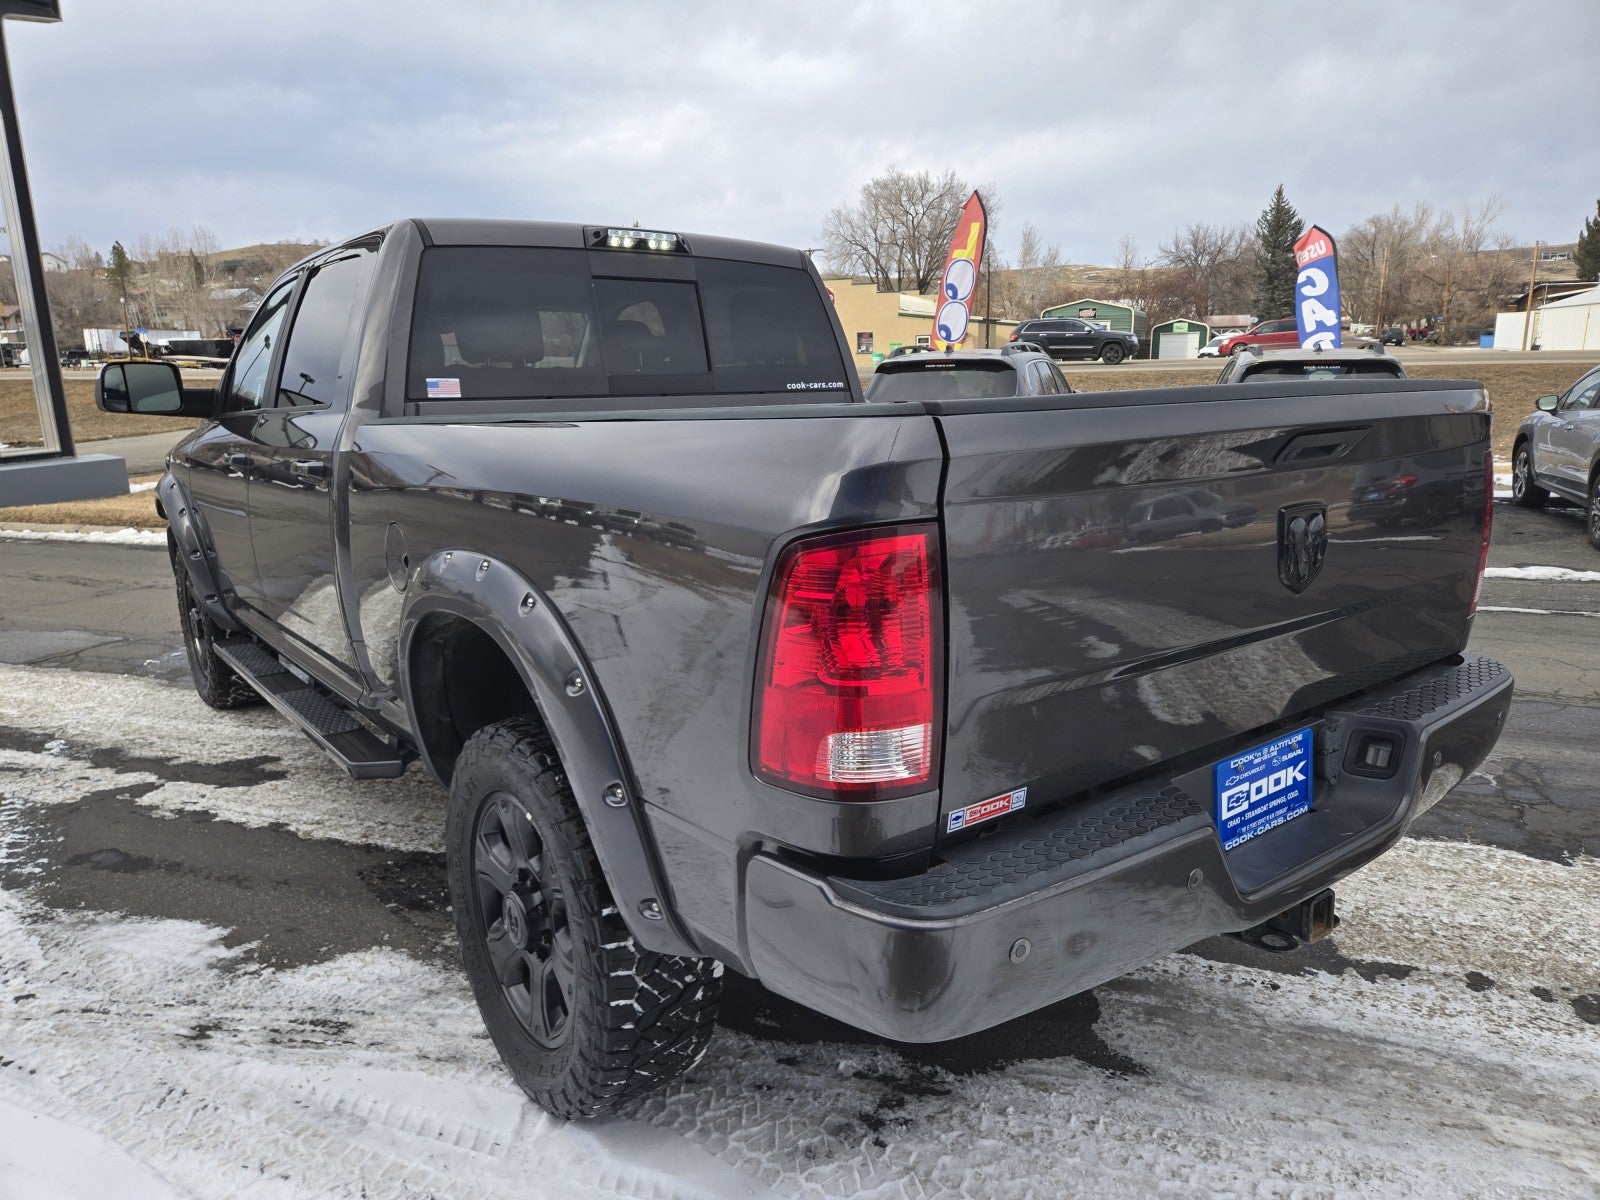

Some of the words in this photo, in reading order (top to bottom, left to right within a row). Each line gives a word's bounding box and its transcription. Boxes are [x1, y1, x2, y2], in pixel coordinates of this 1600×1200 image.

[786, 381, 844, 389] cook-cars.com
[1269, 733, 1303, 752] ALTITUDE
[1281, 748, 1304, 762] SUBARU
[1222, 760, 1307, 821] COOK
[966, 797, 1010, 821] COOK
[1225, 804, 1309, 851] COOK-CARS.COM
